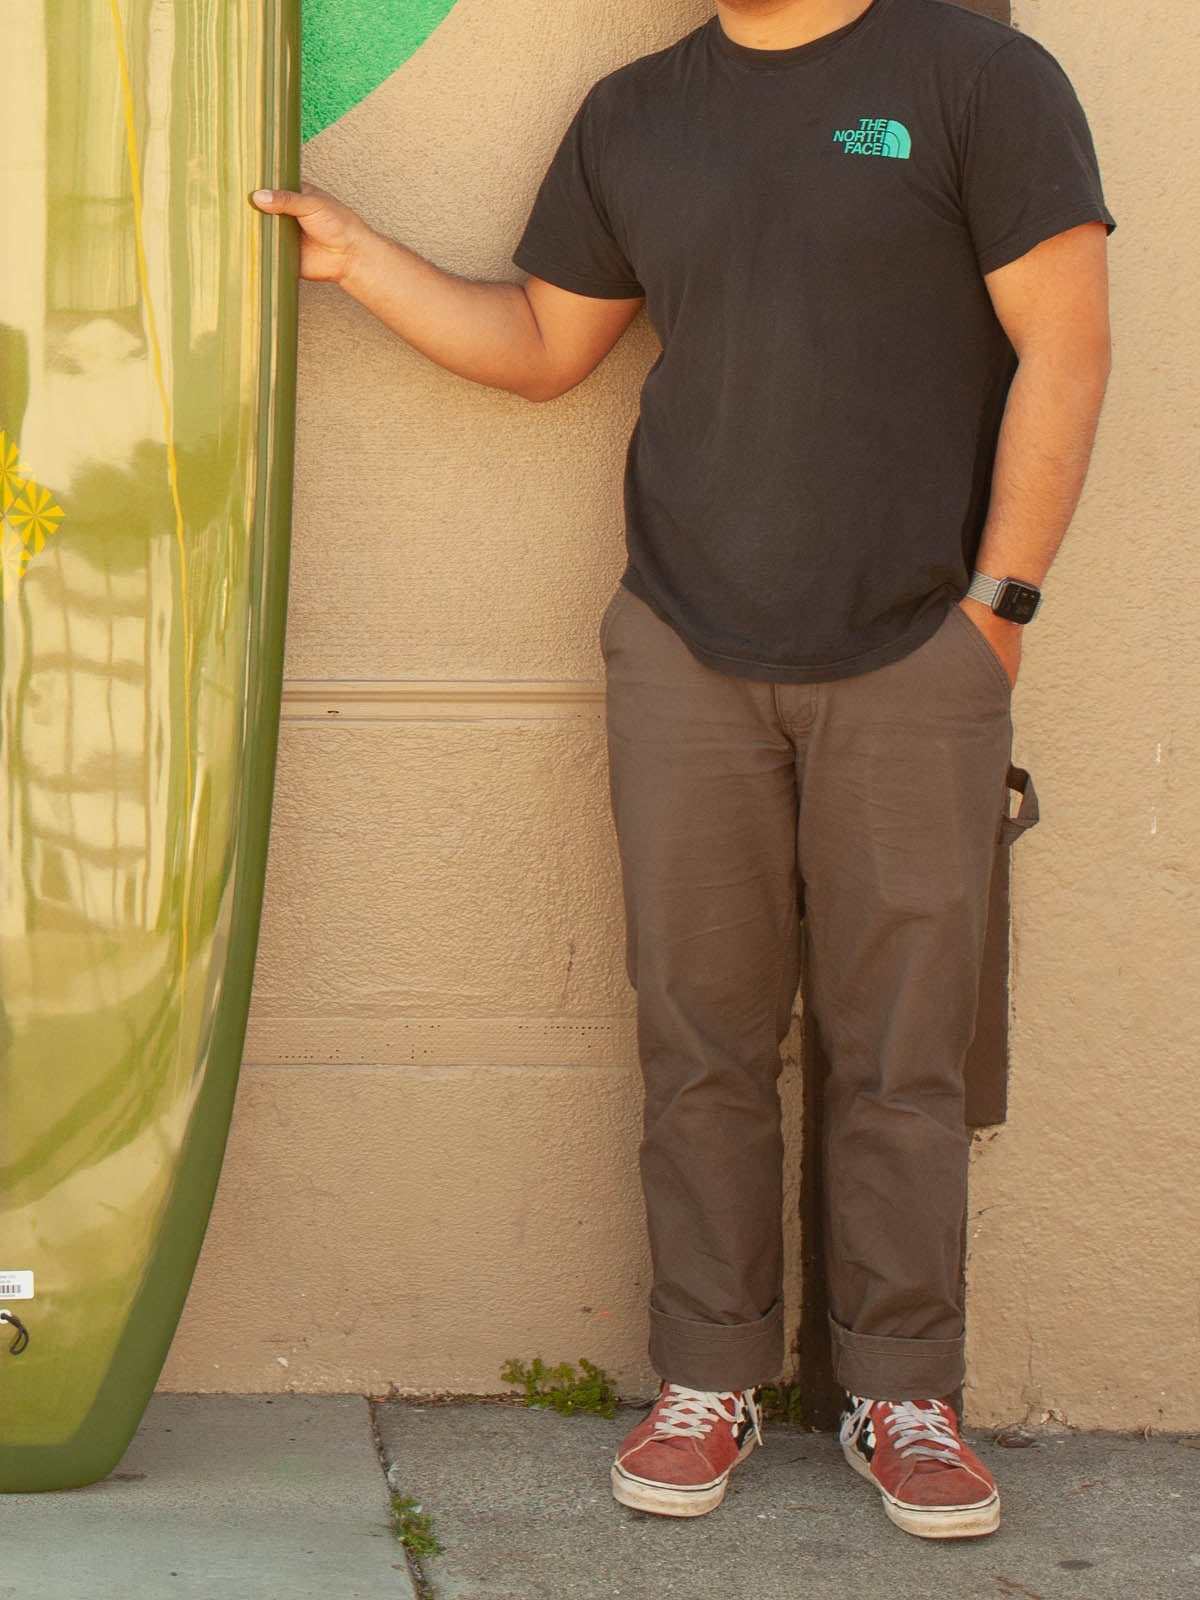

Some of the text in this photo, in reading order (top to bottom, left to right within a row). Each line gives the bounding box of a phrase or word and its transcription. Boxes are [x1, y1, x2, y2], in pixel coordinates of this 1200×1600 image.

[859, 118, 887, 131] THE
[833, 130, 885, 143] NORTH
[844, 142, 882, 155] FACE
